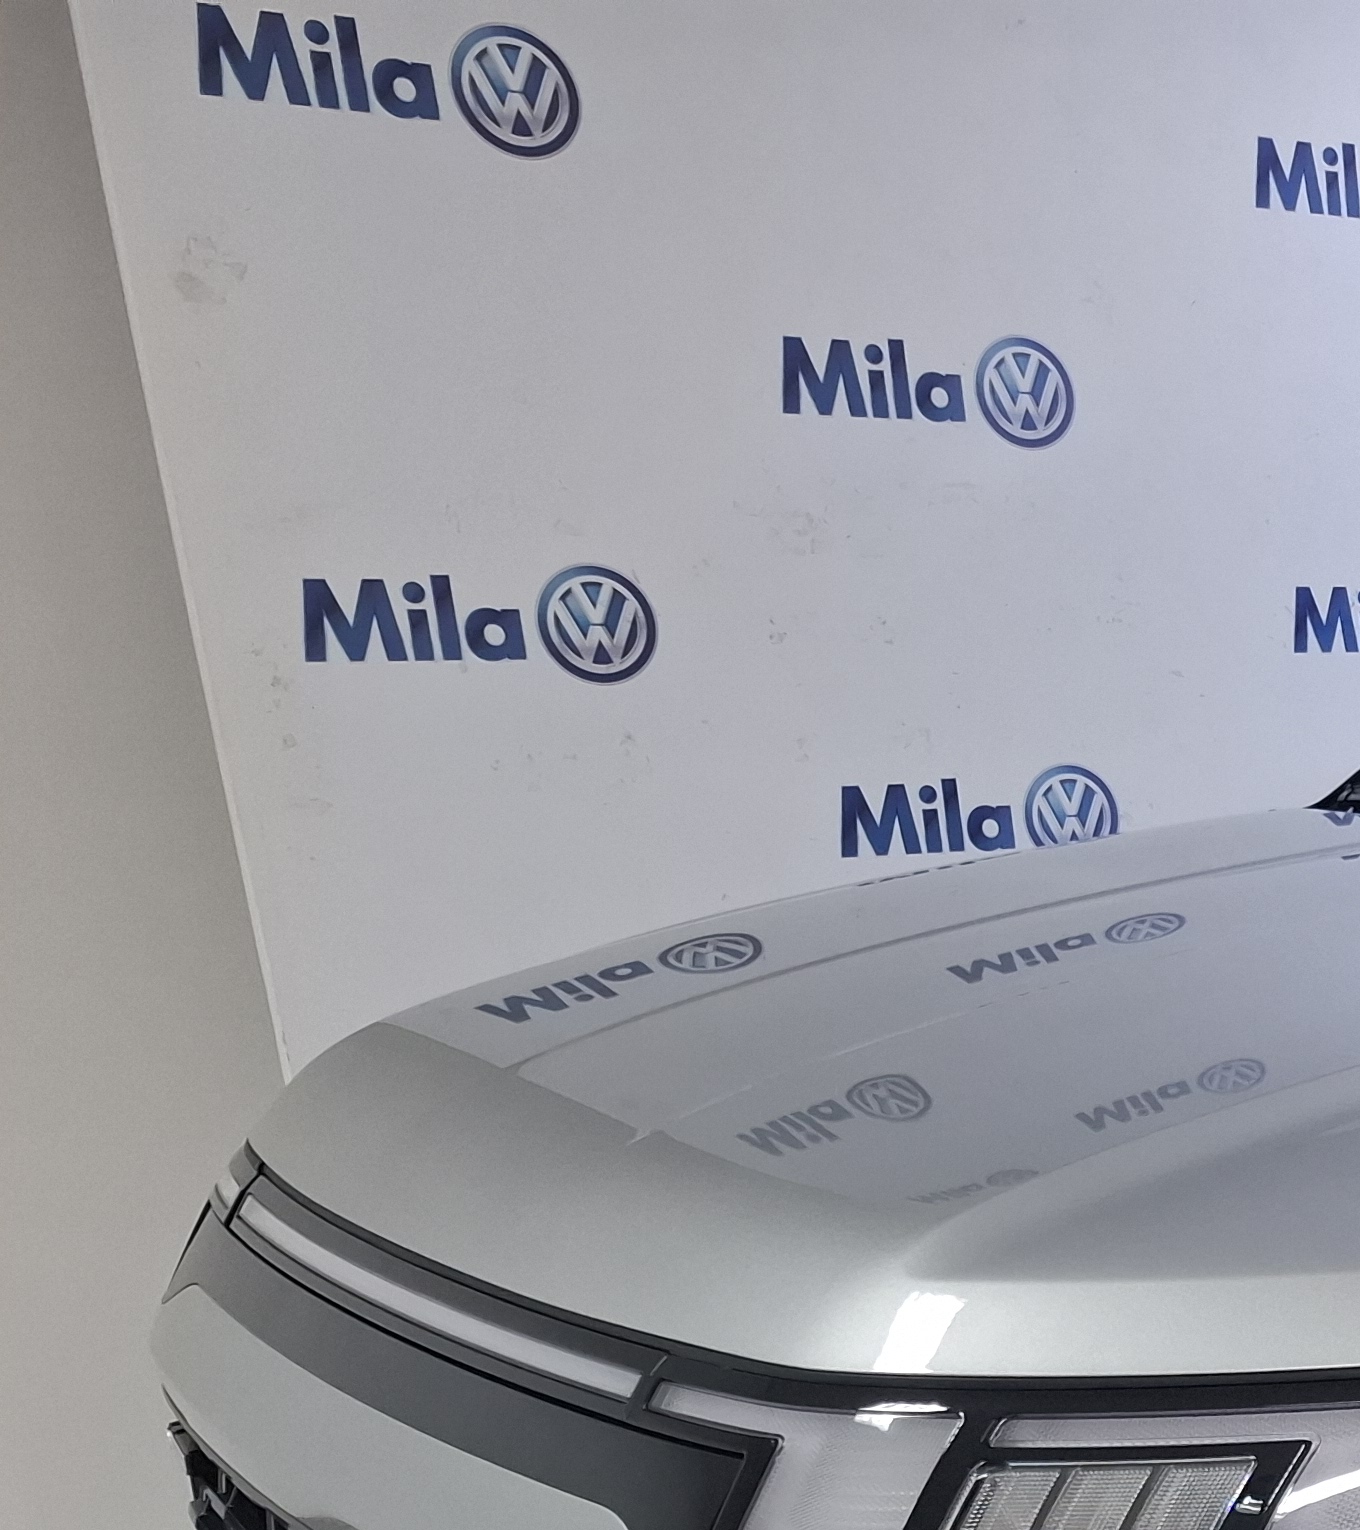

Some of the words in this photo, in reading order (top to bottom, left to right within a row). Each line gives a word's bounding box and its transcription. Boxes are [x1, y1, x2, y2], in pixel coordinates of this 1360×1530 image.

[197, 3, 440, 120] Mila
[783, 336, 965, 422] Mila
[303, 575, 526, 662] Mila
[841, 778, 1015, 857] Mila
